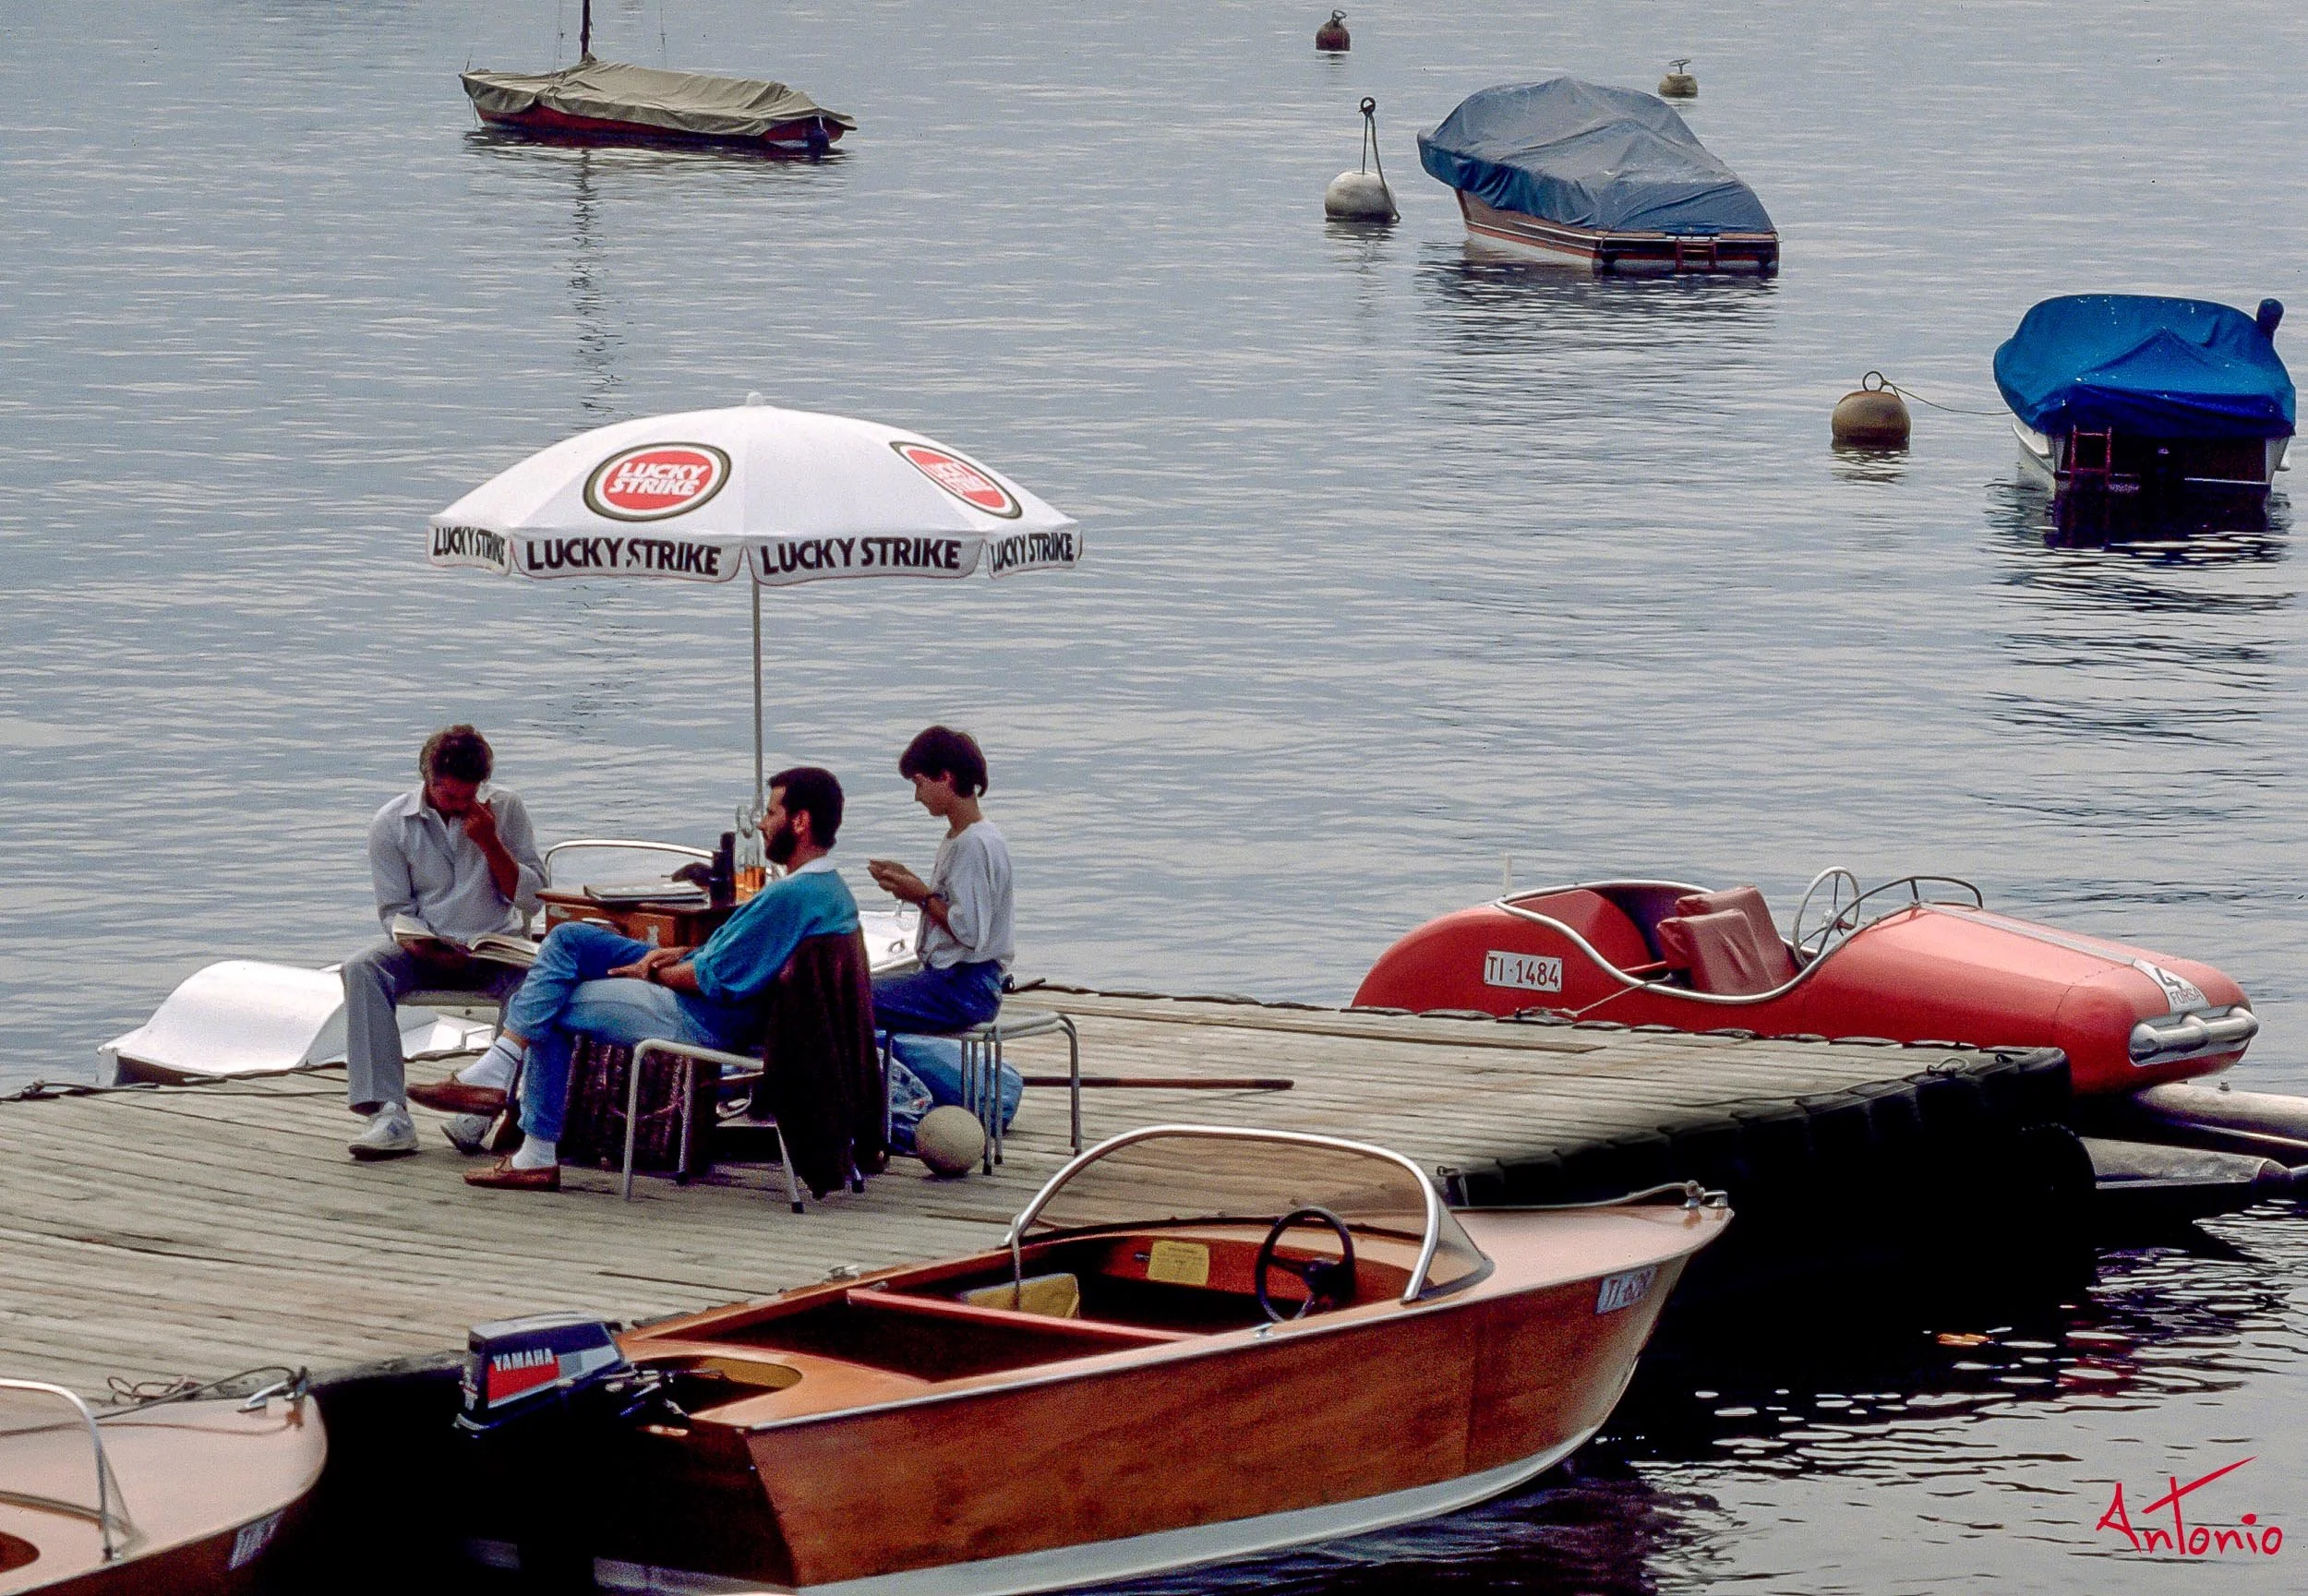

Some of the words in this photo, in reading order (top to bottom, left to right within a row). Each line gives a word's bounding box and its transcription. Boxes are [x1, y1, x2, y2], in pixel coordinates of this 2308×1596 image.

[617, 462, 709, 480] LUCKY
[608, 477, 700, 496] STRIKE
[525, 537, 623, 570] LUCKY
[626, 537, 722, 576] STRIKE
[761, 537, 856, 575] LUCKY
[860, 537, 962, 570] STRIKE
[989, 534, 1026, 572] LUCKY
[1028, 533, 1075, 562] STRIKE
[1516, 959, 1559, 988] 1484
[492, 1348, 554, 1372] YAMAHA
